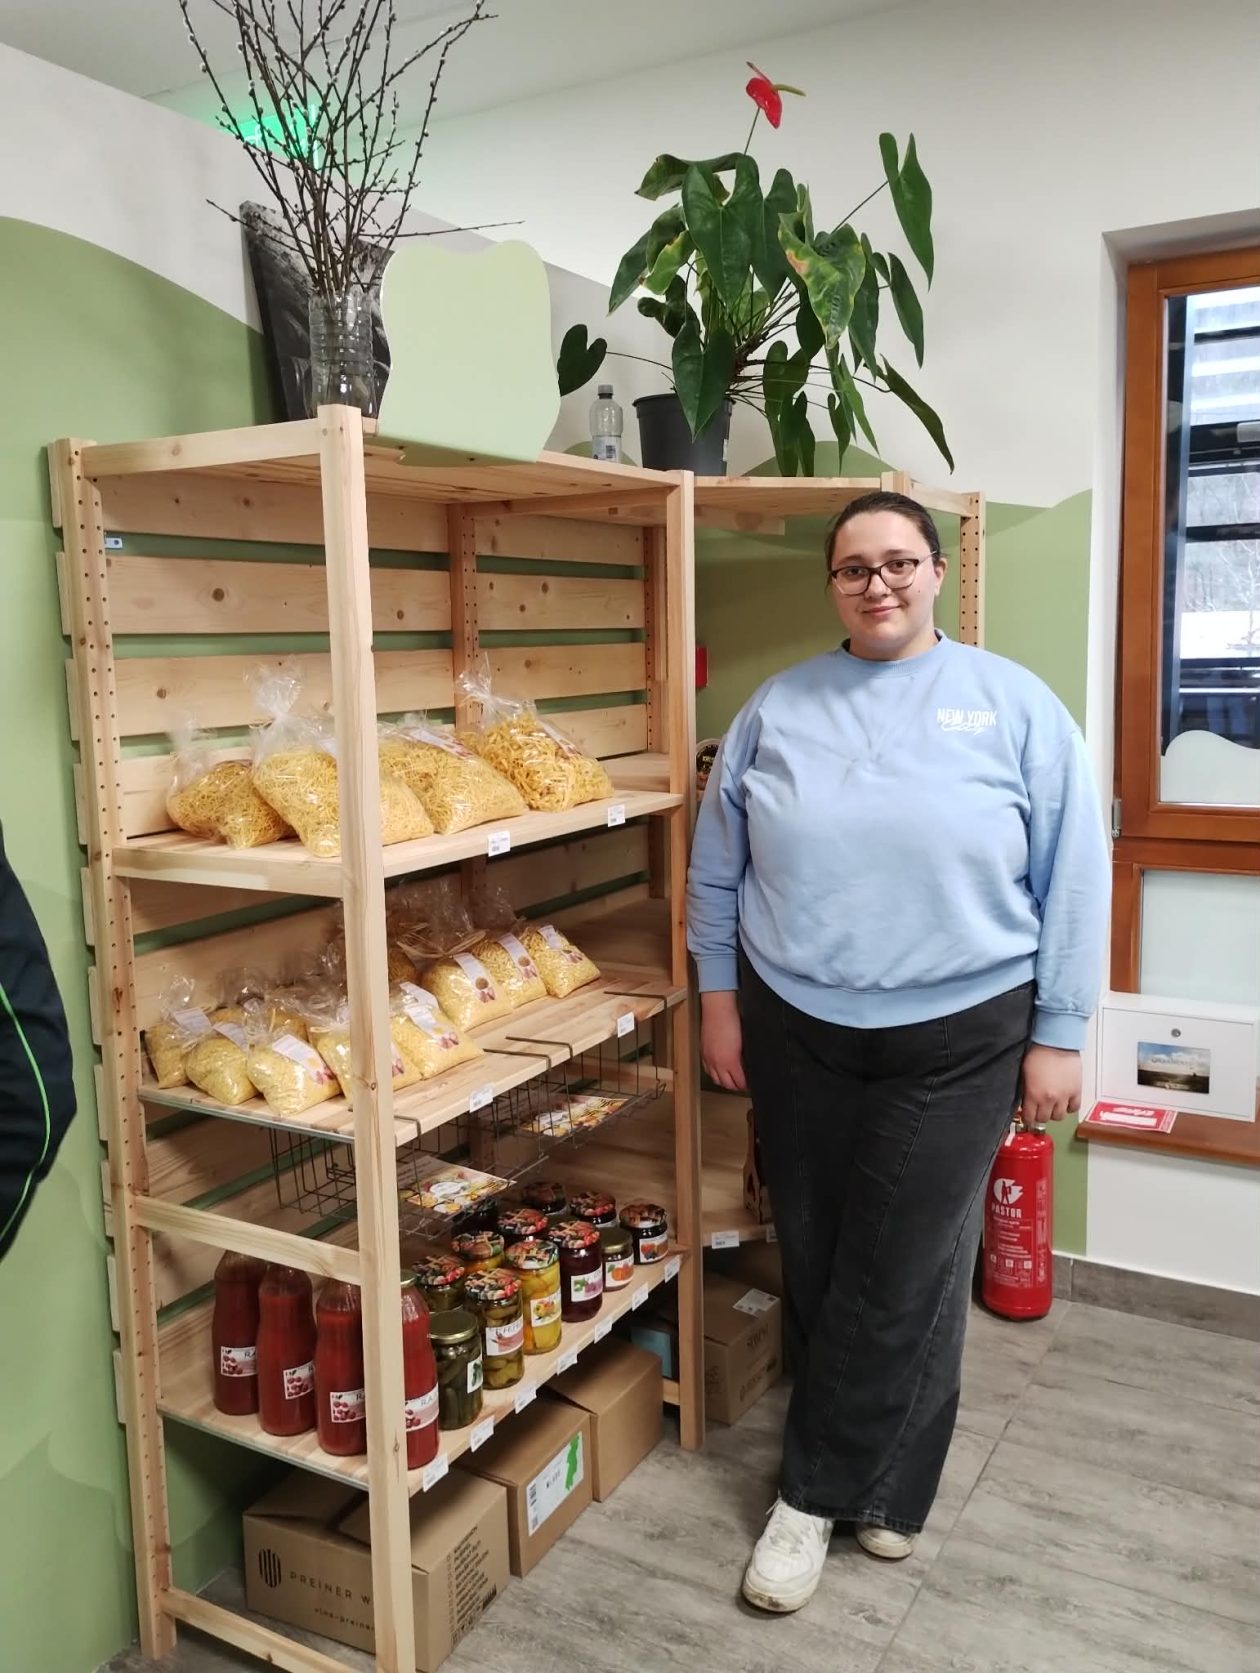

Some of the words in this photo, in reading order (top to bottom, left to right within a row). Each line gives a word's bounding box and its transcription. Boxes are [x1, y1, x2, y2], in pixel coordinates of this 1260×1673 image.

[937, 708, 963, 725] NEW
[967, 710, 997, 728] YORK
[991, 1202, 1022, 1219] PASTOR
[289, 1570, 352, 1599] PREINER
